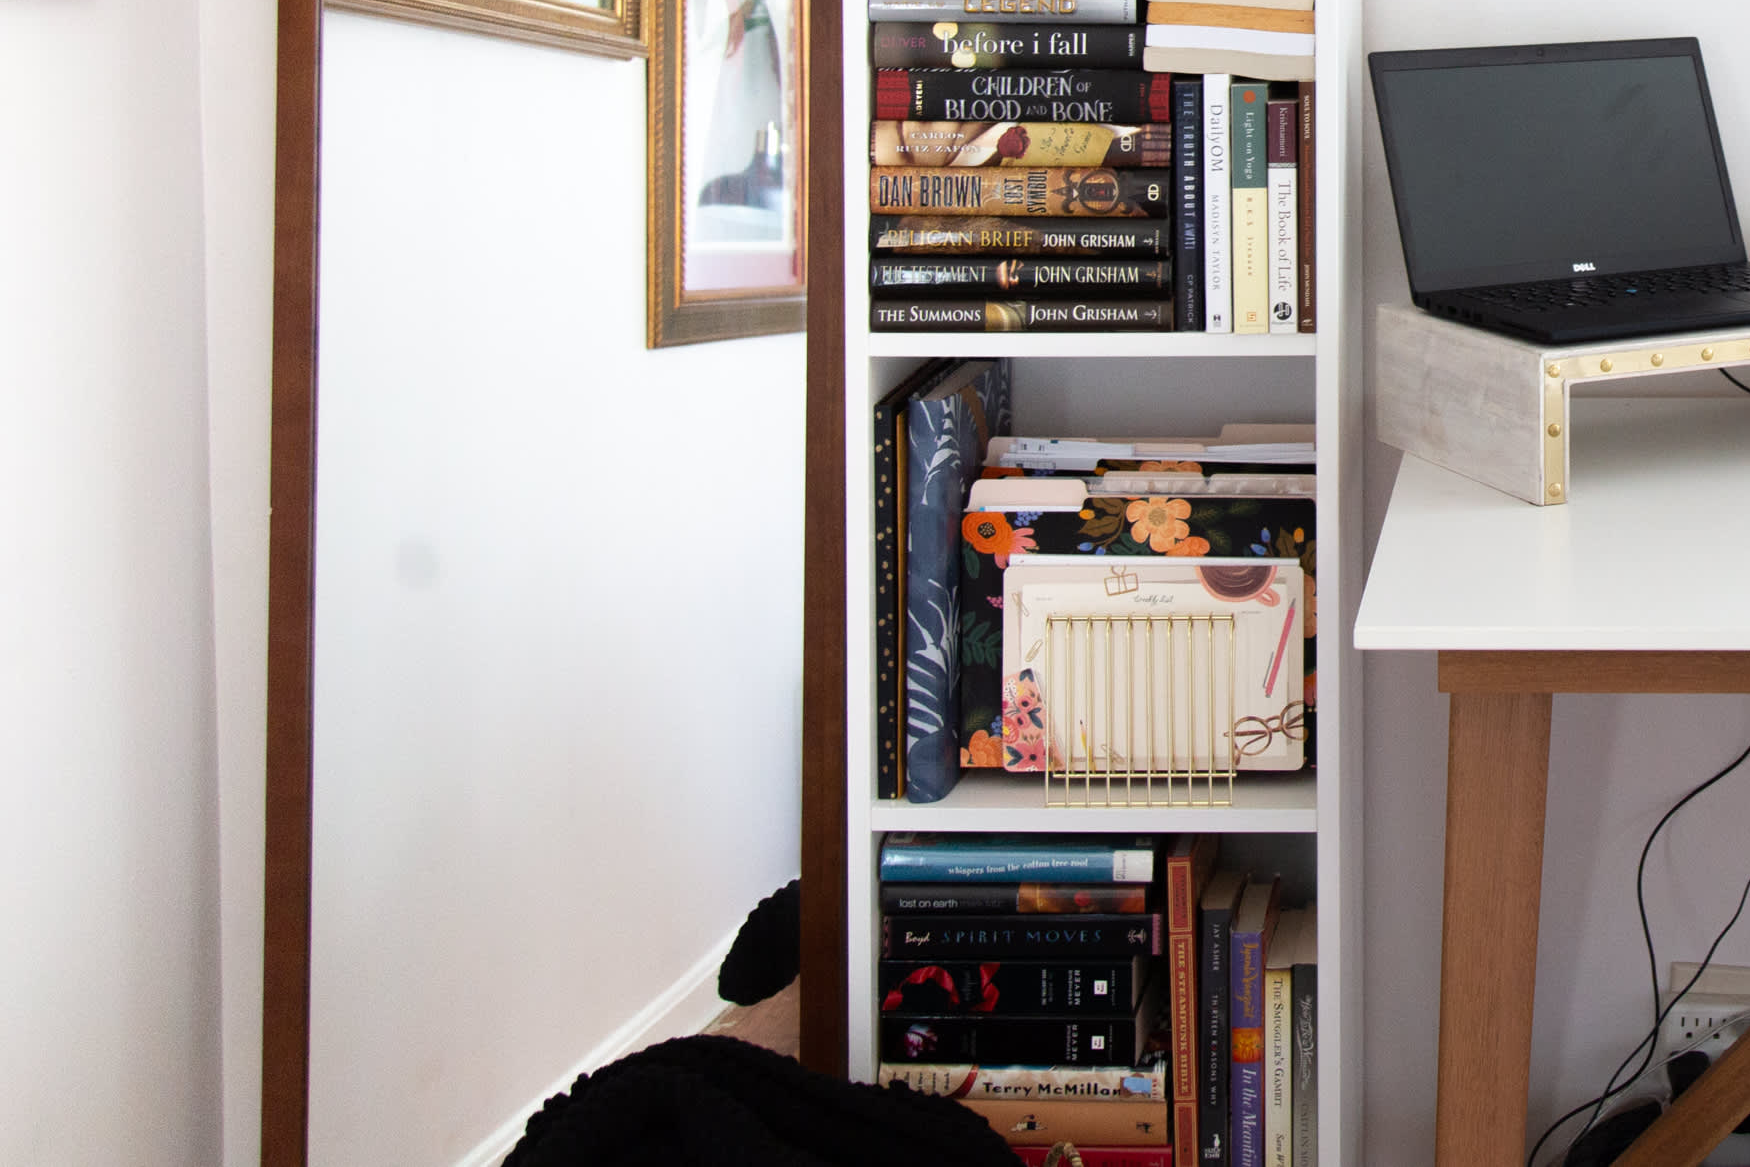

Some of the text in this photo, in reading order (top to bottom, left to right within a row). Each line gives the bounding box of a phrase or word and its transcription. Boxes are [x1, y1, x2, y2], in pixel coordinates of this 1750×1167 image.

[943, 32, 1088, 55] before i fall
[972, 76, 1091, 98] CHILDREN OF
[944, 99, 1113, 122] BLOOD AND BONE
[1207, 104, 1224, 172] DailyOM
[1279, 107, 1288, 157] Krishnamurti
[1244, 111, 1255, 179] Light on Yoga
[879, 175, 982, 207] DAN BROWN
[1004, 178, 1024, 205] LOST
[1027, 170, 1048, 214] SYMBOL
[887, 229, 1033, 247] PELICAN BRIEF
[1042, 233, 1136, 248] JOHN GRISHAM
[1278, 180, 1291, 291] The Book of Life
[880, 265, 988, 283] THE TESTAMENT
[1034, 266, 1139, 288] JOHN GRISHAM
[1573, 263, 1596, 272] DELL
[878, 305, 981, 322] THE SUMMONS
[1029, 305, 1139, 325] JOHN GRISHAM
[933, 898, 958, 908] earth
[905, 931, 930, 946] Boyd
[941, 930, 1102, 943] SPIRIT MOVES
[1212, 924, 1220, 971] JAY ASHER
[1177, 942, 1189, 1093] THE STEAMPUNK BIBLE
[1273, 978, 1283, 1108] THE SMUGGLER'S GAMBIT
[983, 1082, 1121, 1096] Terry McMillan
